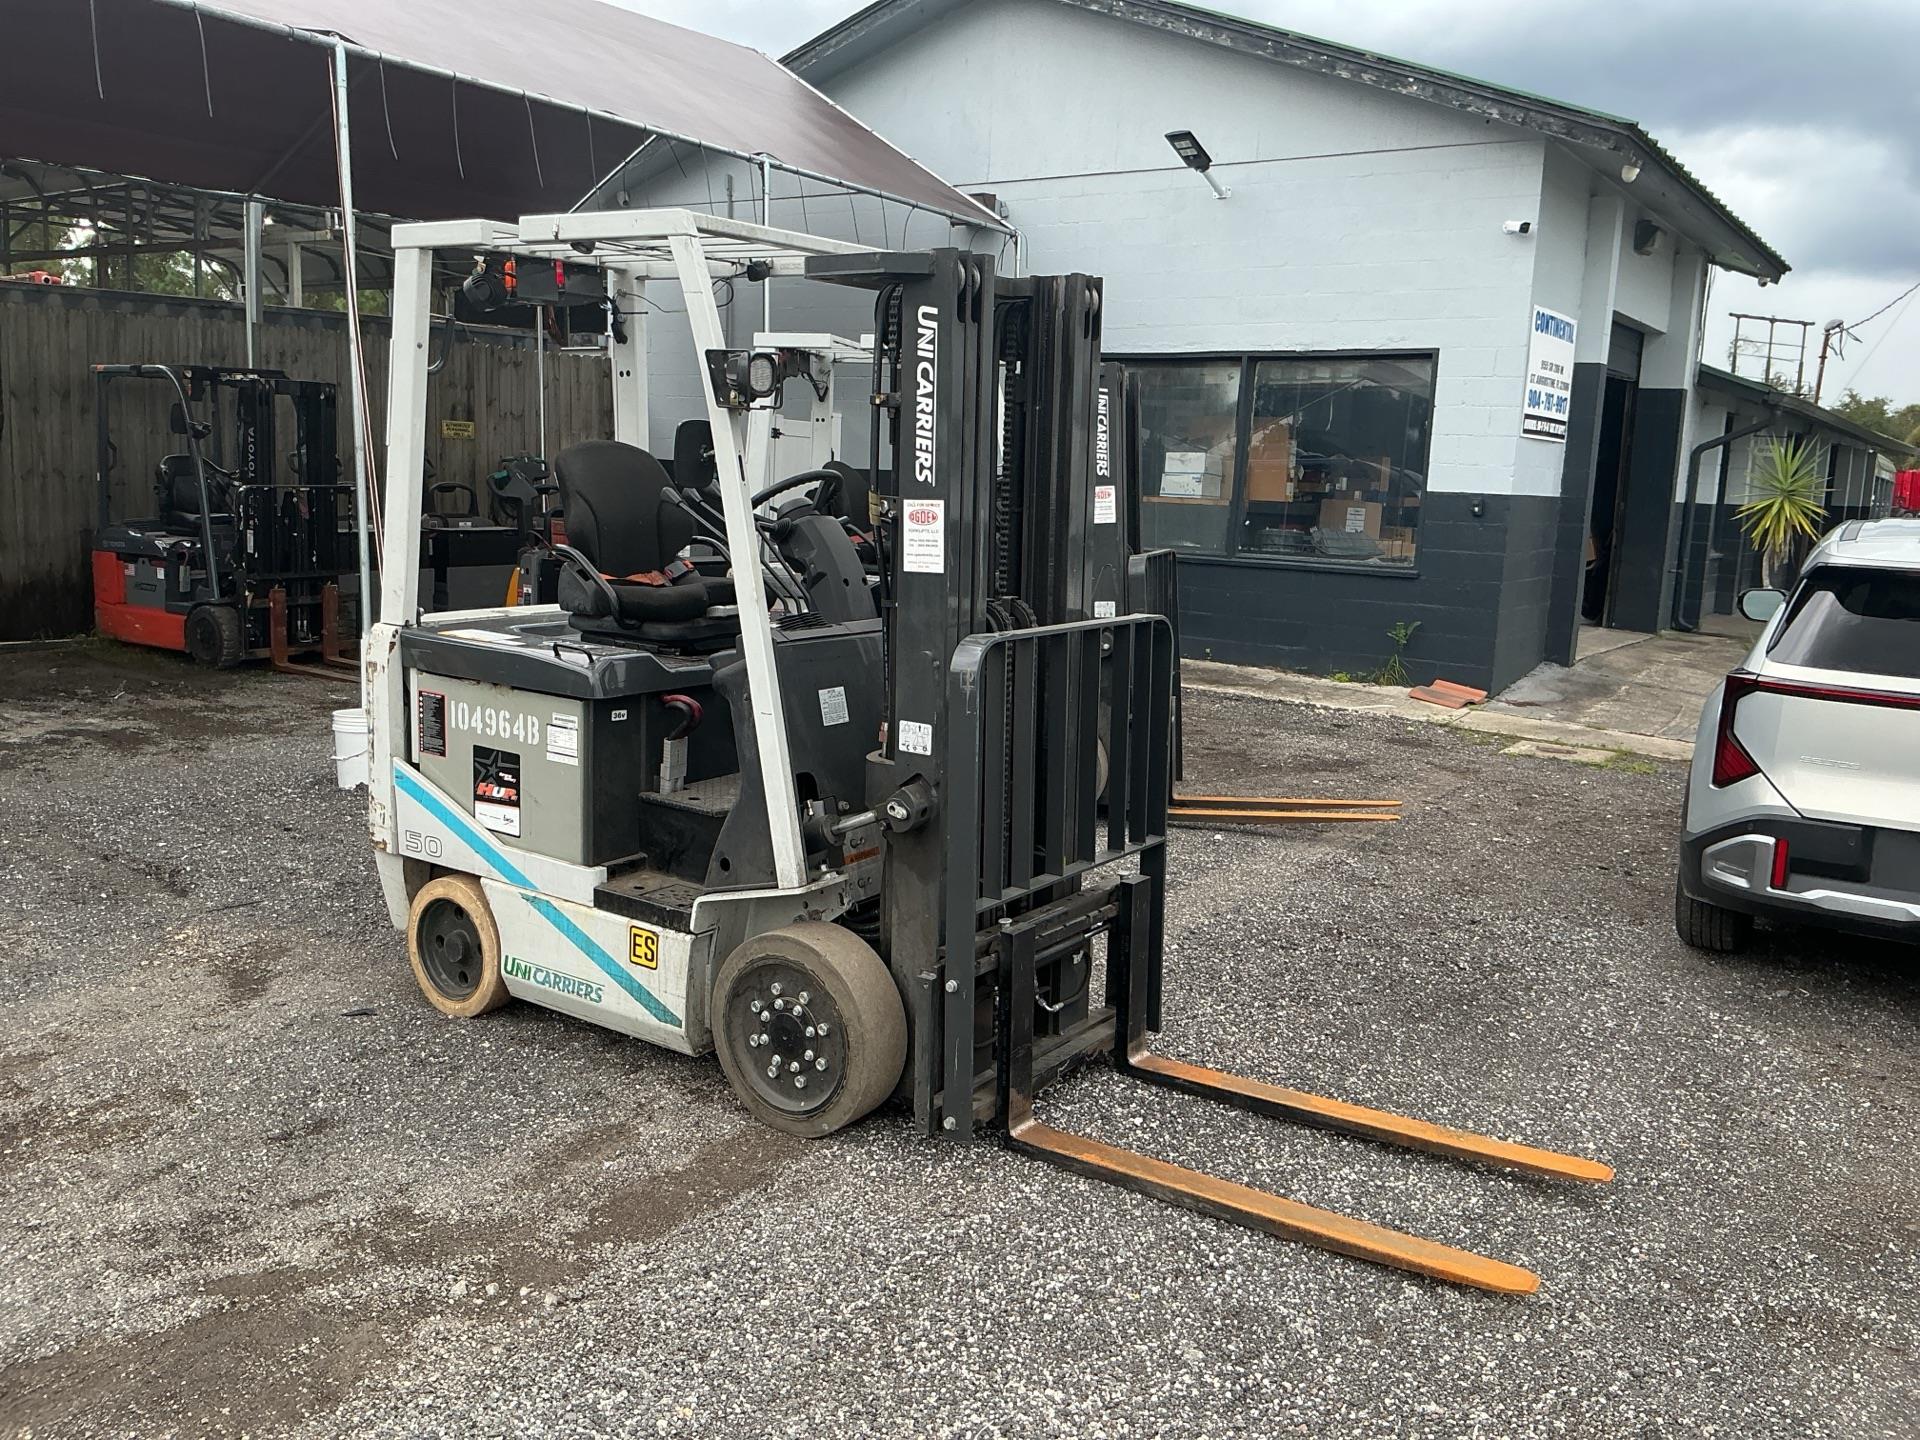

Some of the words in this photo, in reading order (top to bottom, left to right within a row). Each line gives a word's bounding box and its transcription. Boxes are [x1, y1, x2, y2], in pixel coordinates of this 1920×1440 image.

[1535, 310, 1575, 344] CONTINENTAL
[248, 426, 256, 479] TOYOTA
[909, 510, 937, 524] OGDEN
[450, 700, 540, 746] 104964B
[405, 829, 442, 858] 50
[632, 932, 655, 963] ES
